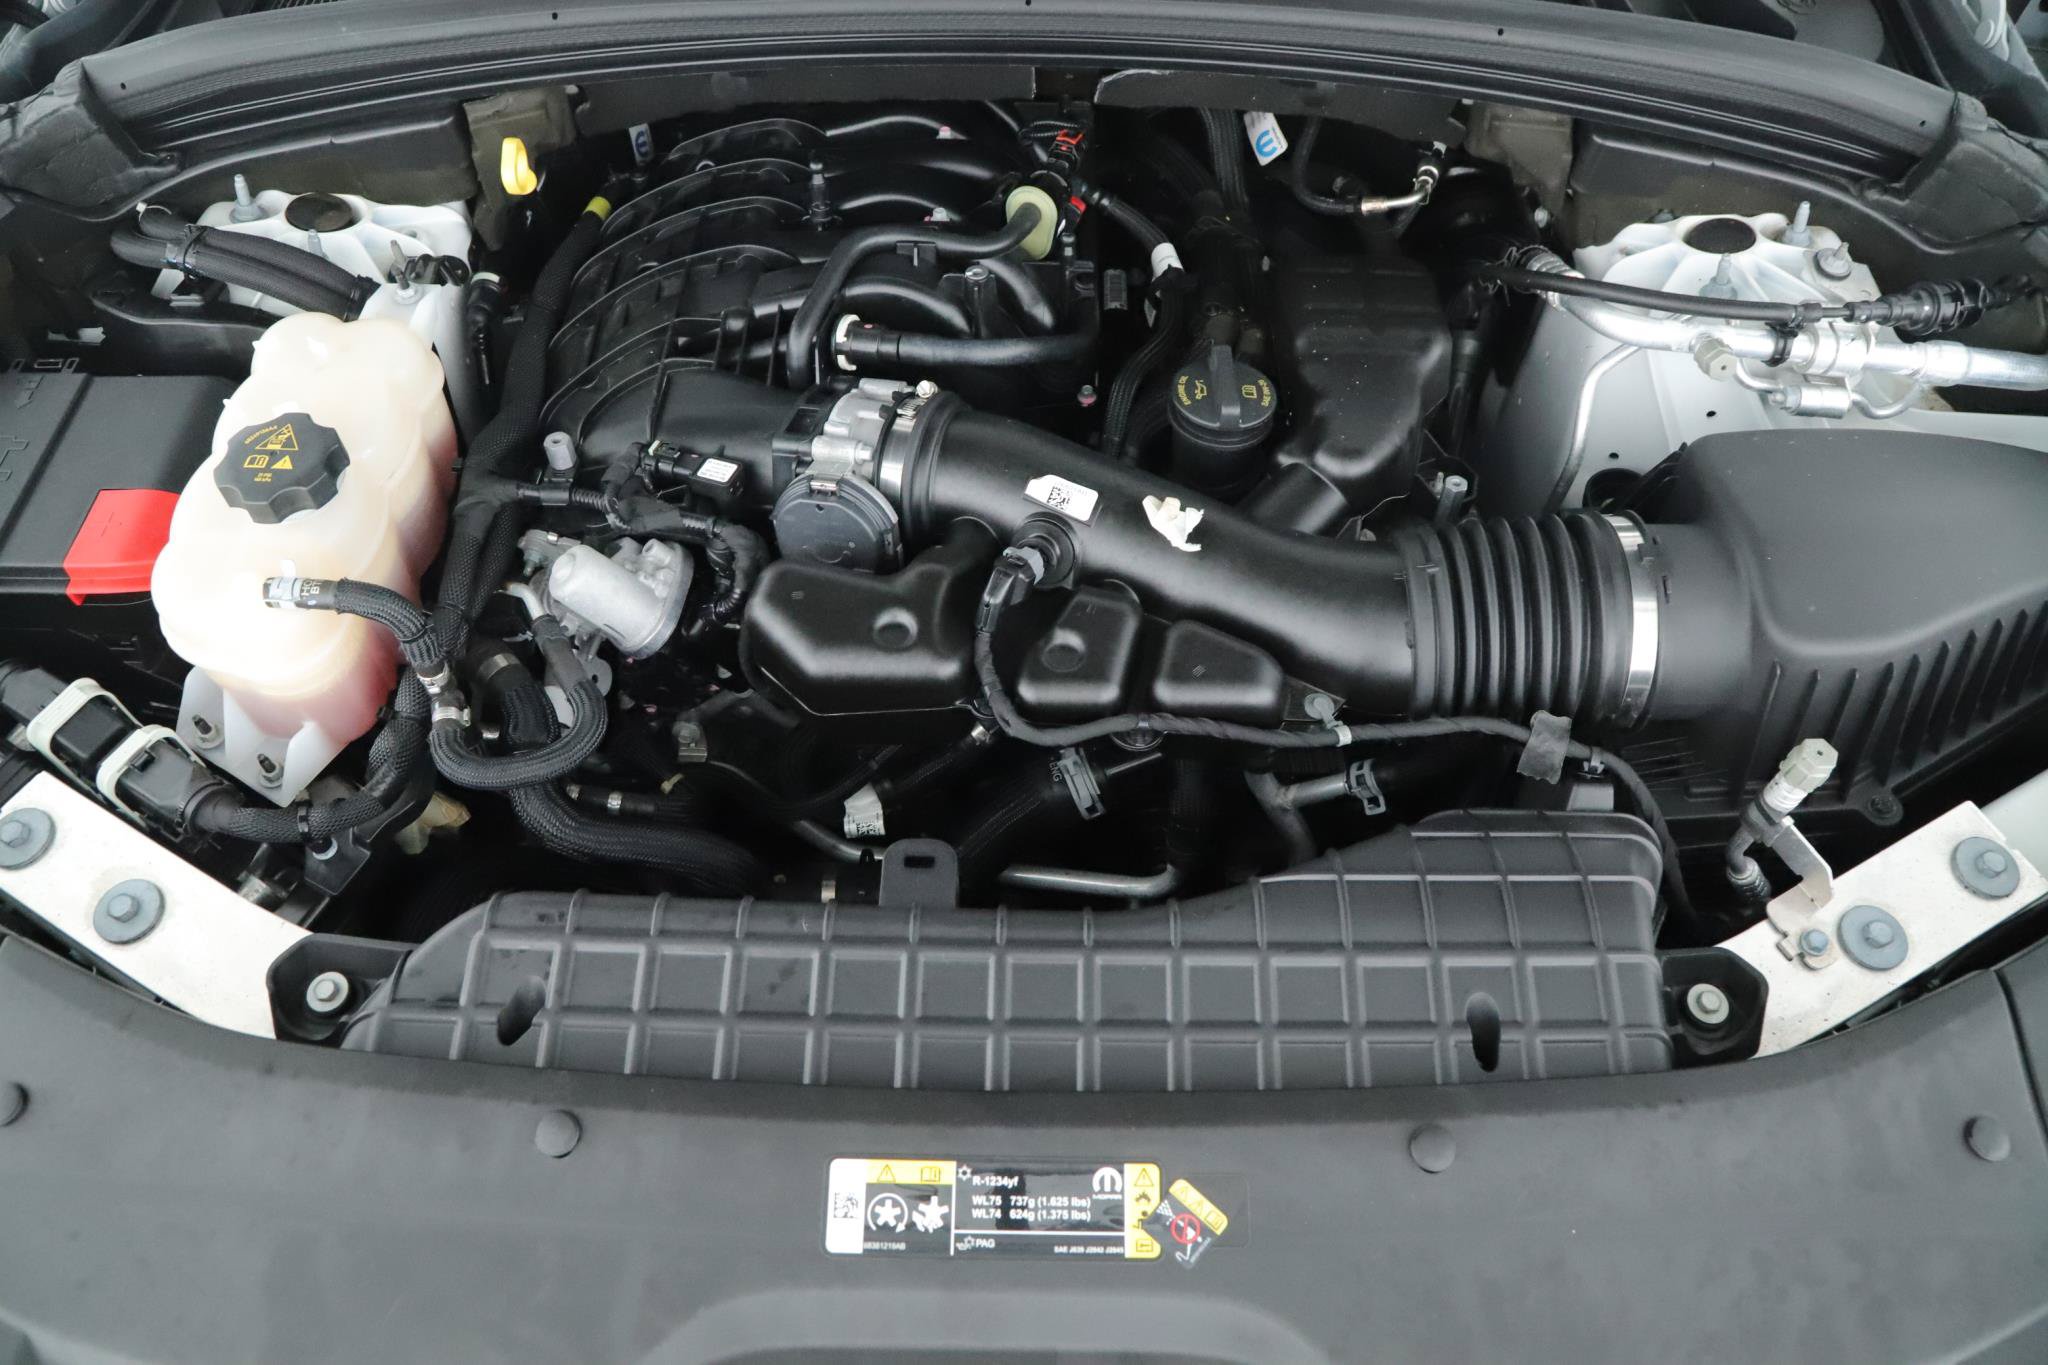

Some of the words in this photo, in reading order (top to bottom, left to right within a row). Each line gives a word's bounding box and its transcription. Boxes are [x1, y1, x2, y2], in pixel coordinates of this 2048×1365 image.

[971, 1175, 1019, 1189] R-1234yf
[971, 1195, 1002, 1206] WL75
[1009, 1195, 1036, 1208] 737g
[1037, 1195, 1069, 1208] (1.625
[1070, 1195, 1092, 1208] lbs)
[971, 1208, 1002, 1219] WL74
[1008, 1208, 1035, 1221] 624g
[1037, 1208, 1069, 1221] (1.375
[1070, 1208, 1092, 1222] lbs)
[975, 1238, 996, 1248] PAG
